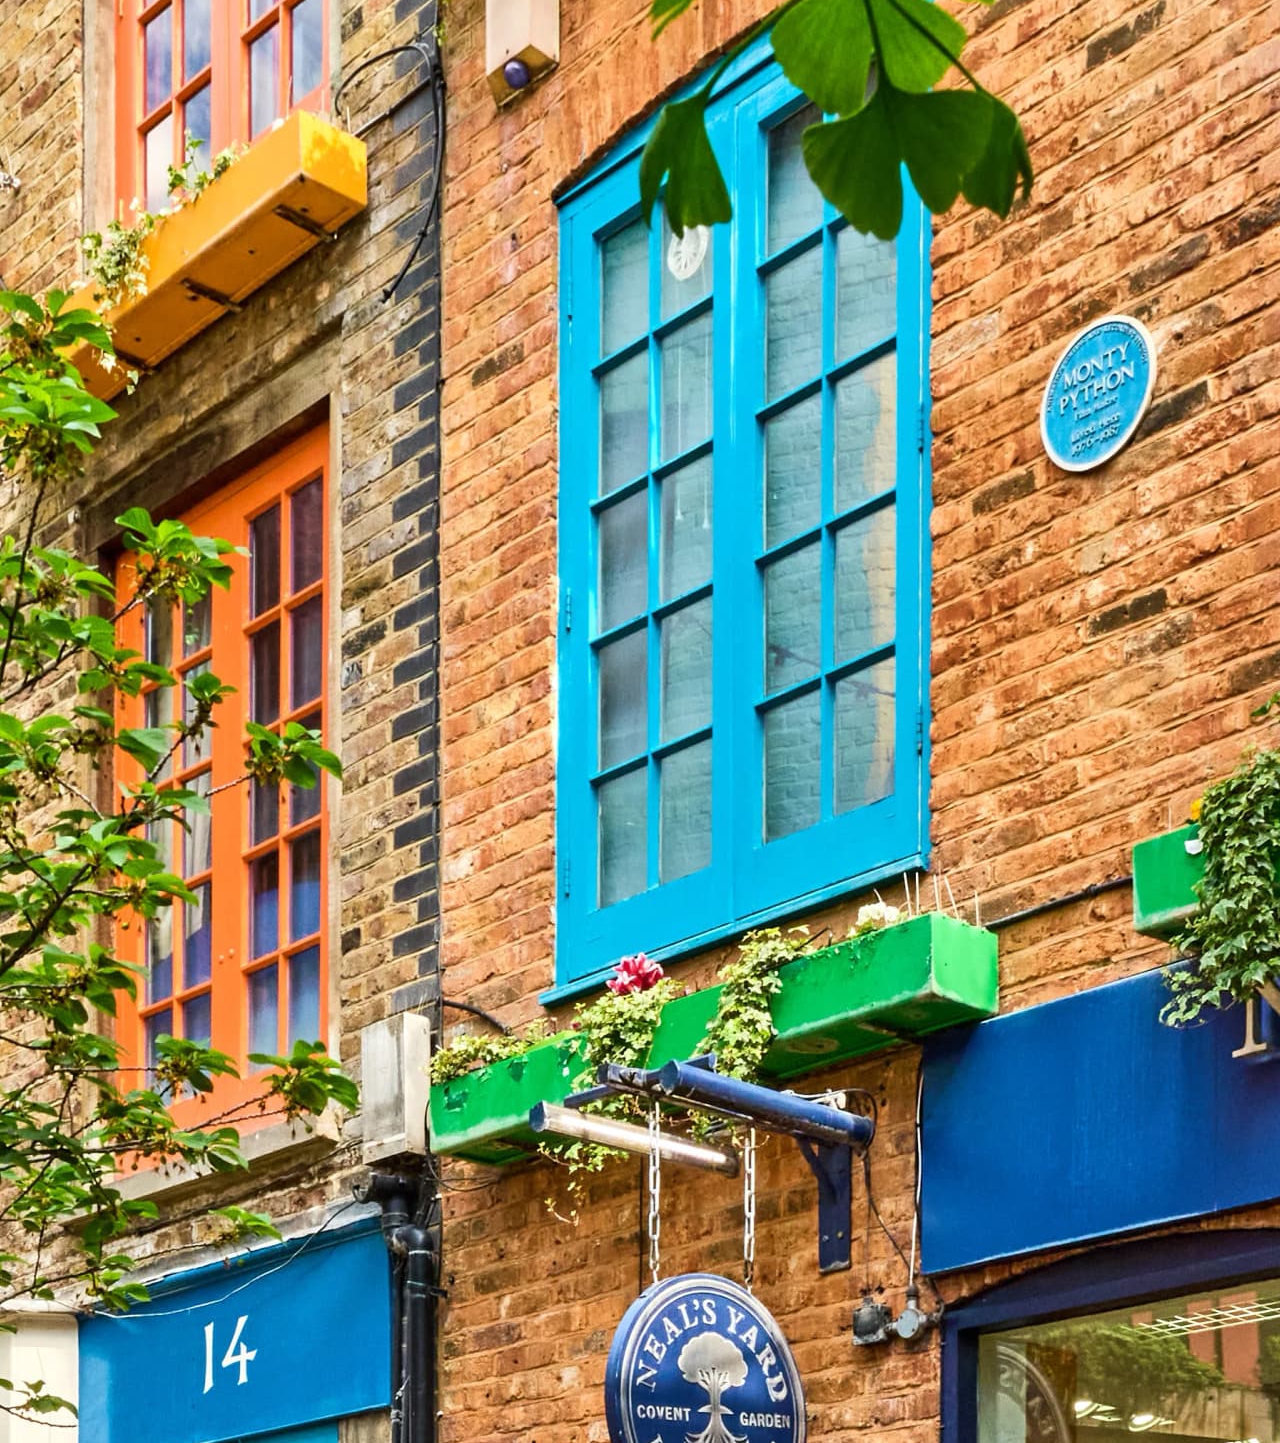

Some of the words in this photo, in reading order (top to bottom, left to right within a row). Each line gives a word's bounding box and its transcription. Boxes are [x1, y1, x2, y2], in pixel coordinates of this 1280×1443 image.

[1059, 361, 1136, 416] PYTHON
[1063, 341, 1132, 390] MONTY
[203, 1315, 258, 1394] 14
[636, 1299, 718, 1393] NEAL'S
[726, 1305, 789, 1403] YARD
[637, 1404, 691, 1422] COVENT
[739, 1412, 790, 1429] GARDEN
